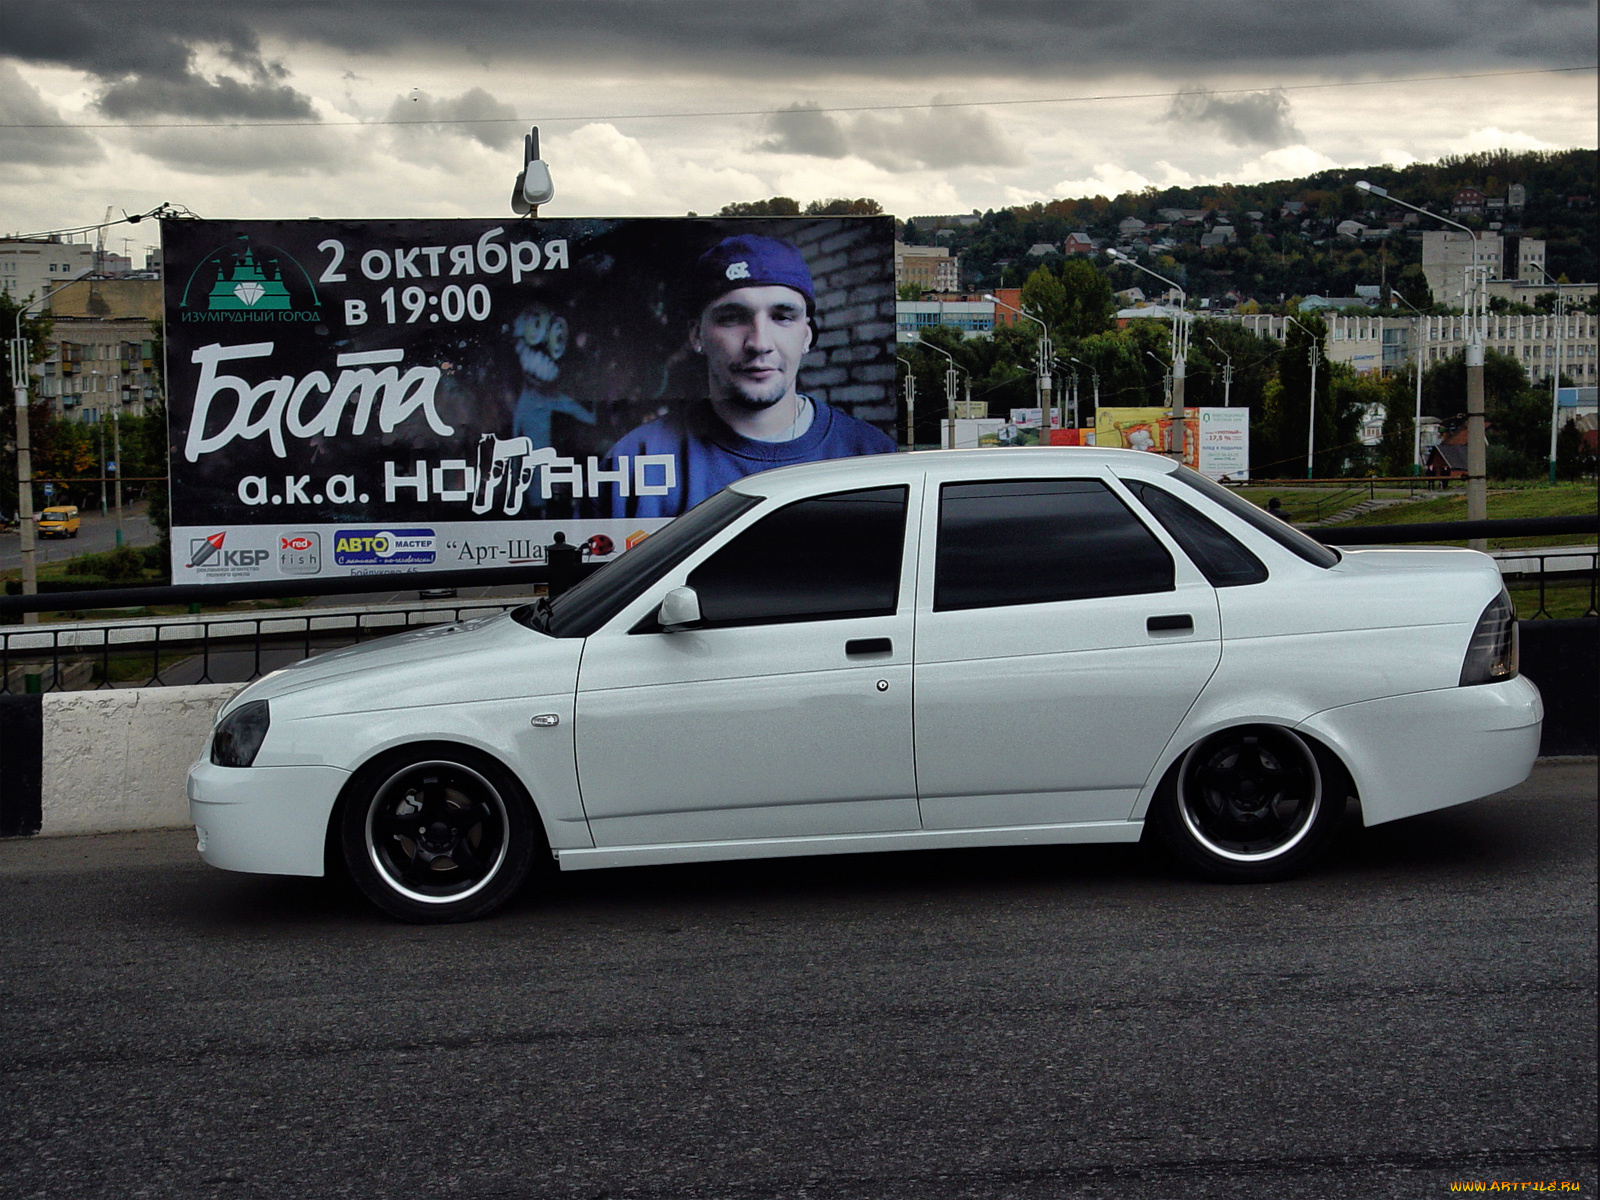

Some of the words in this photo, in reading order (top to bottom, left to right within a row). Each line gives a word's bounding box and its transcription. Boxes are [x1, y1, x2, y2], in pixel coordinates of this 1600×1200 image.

[317, 238, 347, 283] 2
[360, 226, 569, 284] октября
[344, 299, 369, 326] в
[380, 283, 492, 324] 19:00
[181, 310, 275, 322] ИЗУМРУДНЫЙ
[278, 311, 321, 321] ГОРОД
[185, 341, 455, 463] Баста
[237, 474, 370, 505] а.к.а.
[292, 539, 308, 548] red
[336, 537, 388, 552] АВТО
[224, 550, 269, 566] КБР
[281, 554, 317, 564] fish
